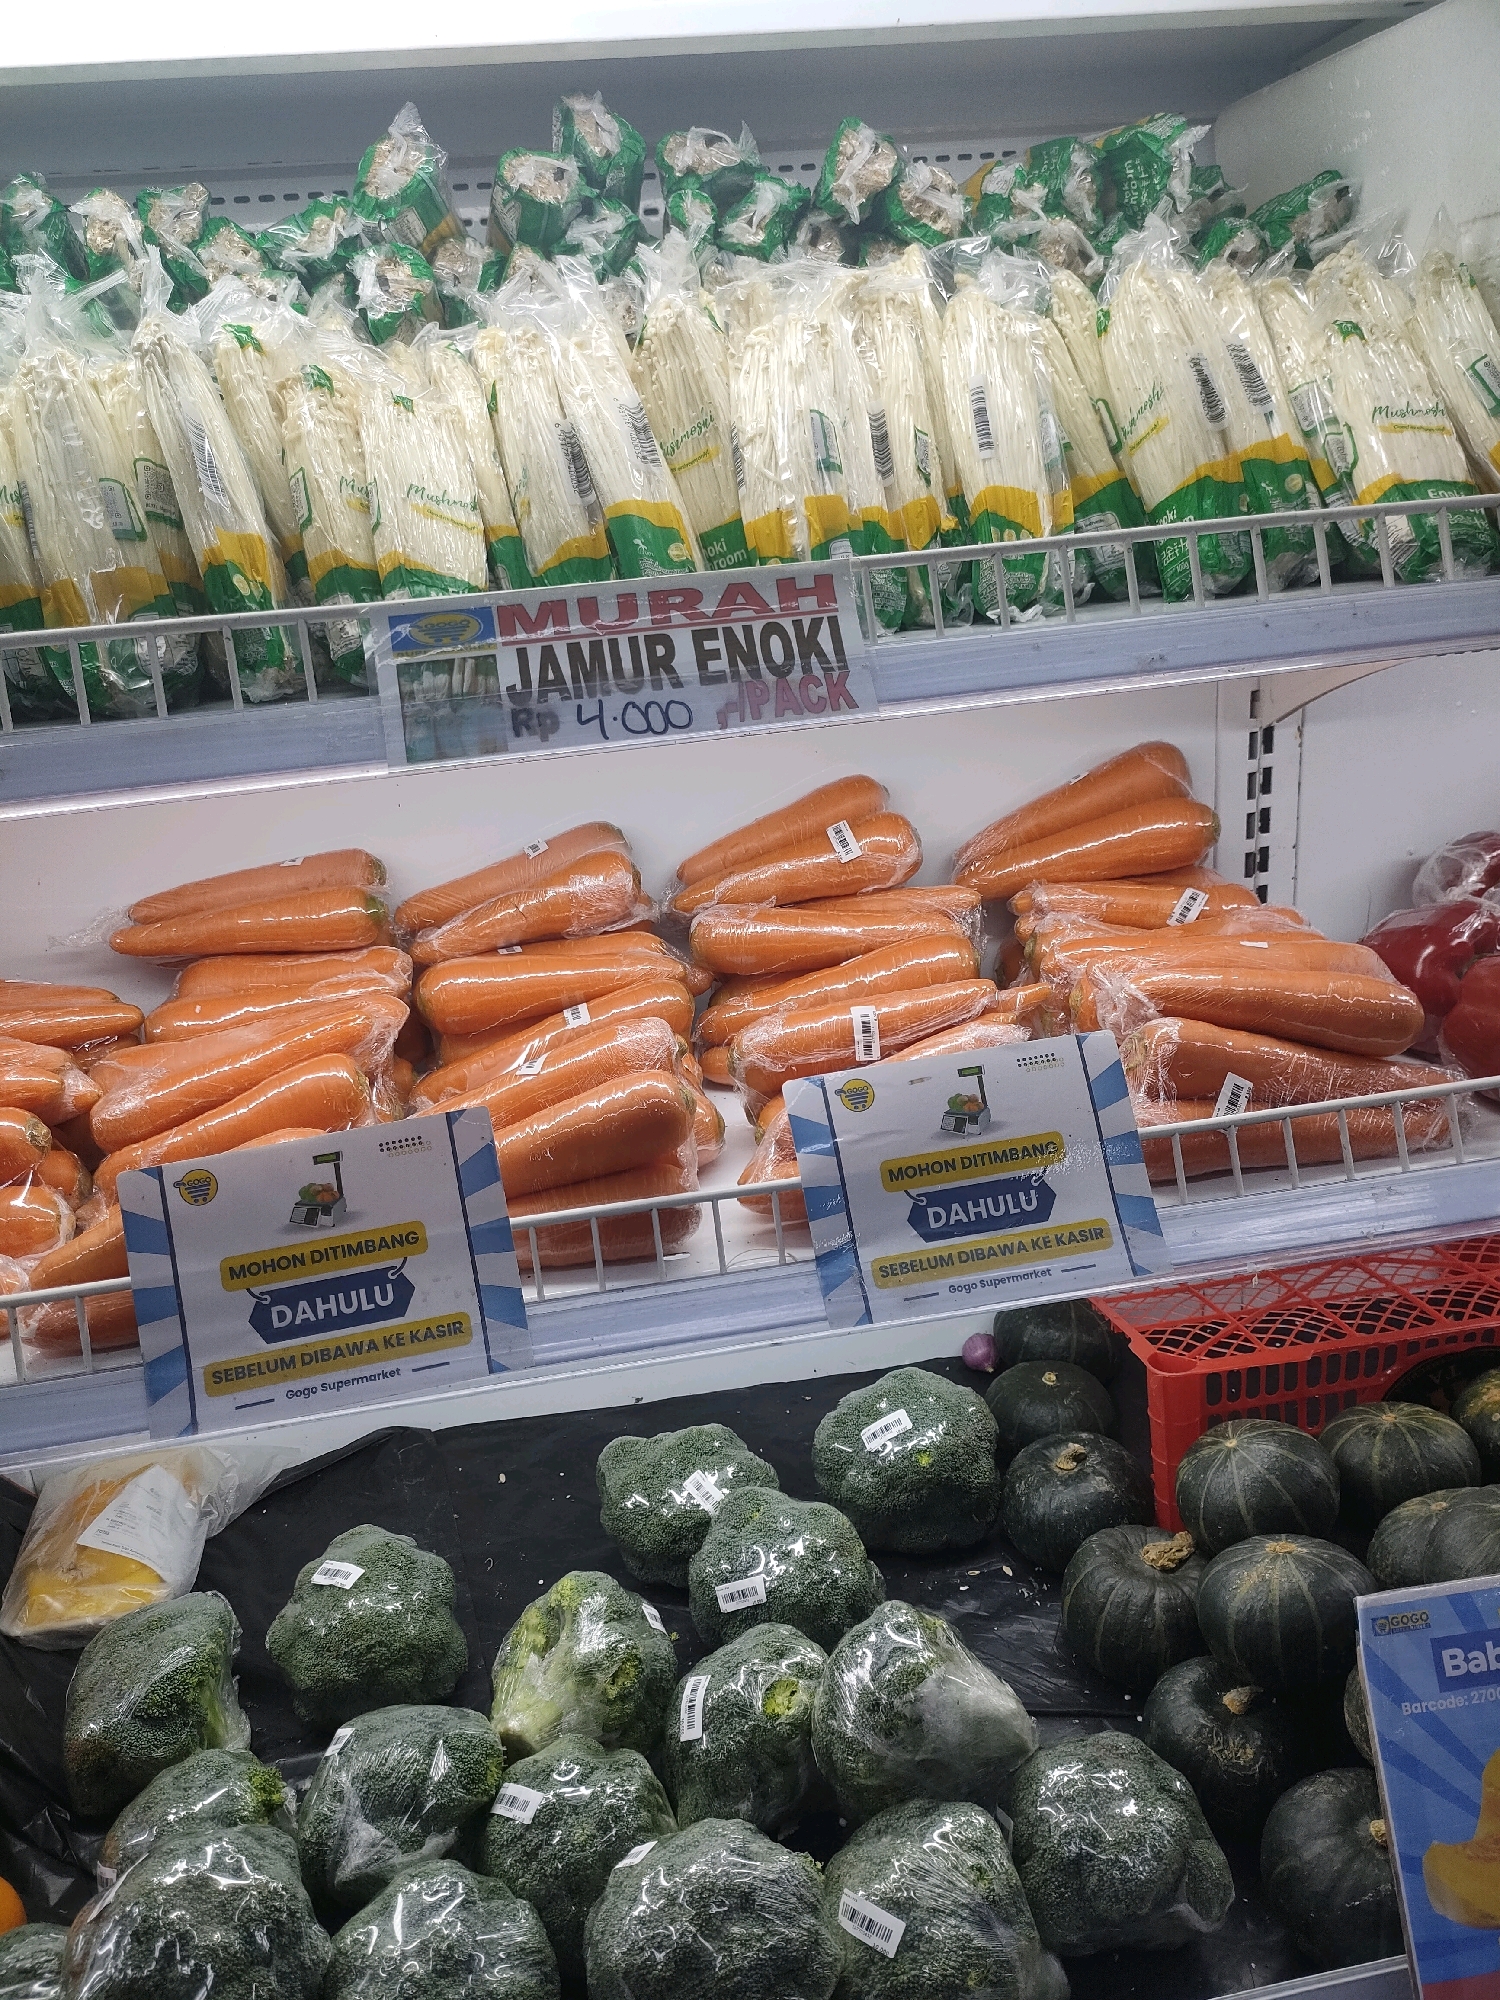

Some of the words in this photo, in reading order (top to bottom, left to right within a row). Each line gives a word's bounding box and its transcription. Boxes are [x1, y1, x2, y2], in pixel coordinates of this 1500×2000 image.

[498, 574, 838, 638] MURAH
[505, 629, 684, 705] JAMUR
[691, 614, 848, 684] ENOKI
[577, 699, 693, 740] 4.000
[847, 1085, 869, 1095] GOGO
[187, 1176, 212, 1187] GOGO
[887, 1157, 958, 1183] MOHON
[960, 1140, 1059, 1171] DITIMBANG
[927, 1189, 1039, 1229] DAHULU
[228, 1251, 307, 1281] MOHON
[310, 1229, 420, 1266] DITIMBANG
[878, 1252, 955, 1279] SEBELUM
[958, 1239, 1029, 1262] DIBAWA
[1031, 1234, 1053, 1250] KE
[1055, 1226, 1105, 1248] KASIR
[948, 1280, 978, 1295] Gogo
[979, 1268, 1053, 1291] Supermarket
[270, 1282, 395, 1331] DAHULU
[211, 1355, 297, 1386] SEBELUM
[301, 1339, 380, 1367] DIBAWA
[383, 1331, 407, 1349] KE
[409, 1319, 465, 1345] KASIR
[285, 1385, 318, 1401] Gogo
[320, 1367, 402, 1393] Supermarket
[1391, 1611, 1429, 1627] GOGO
[1401, 1695, 1469, 1715] Barcode:
